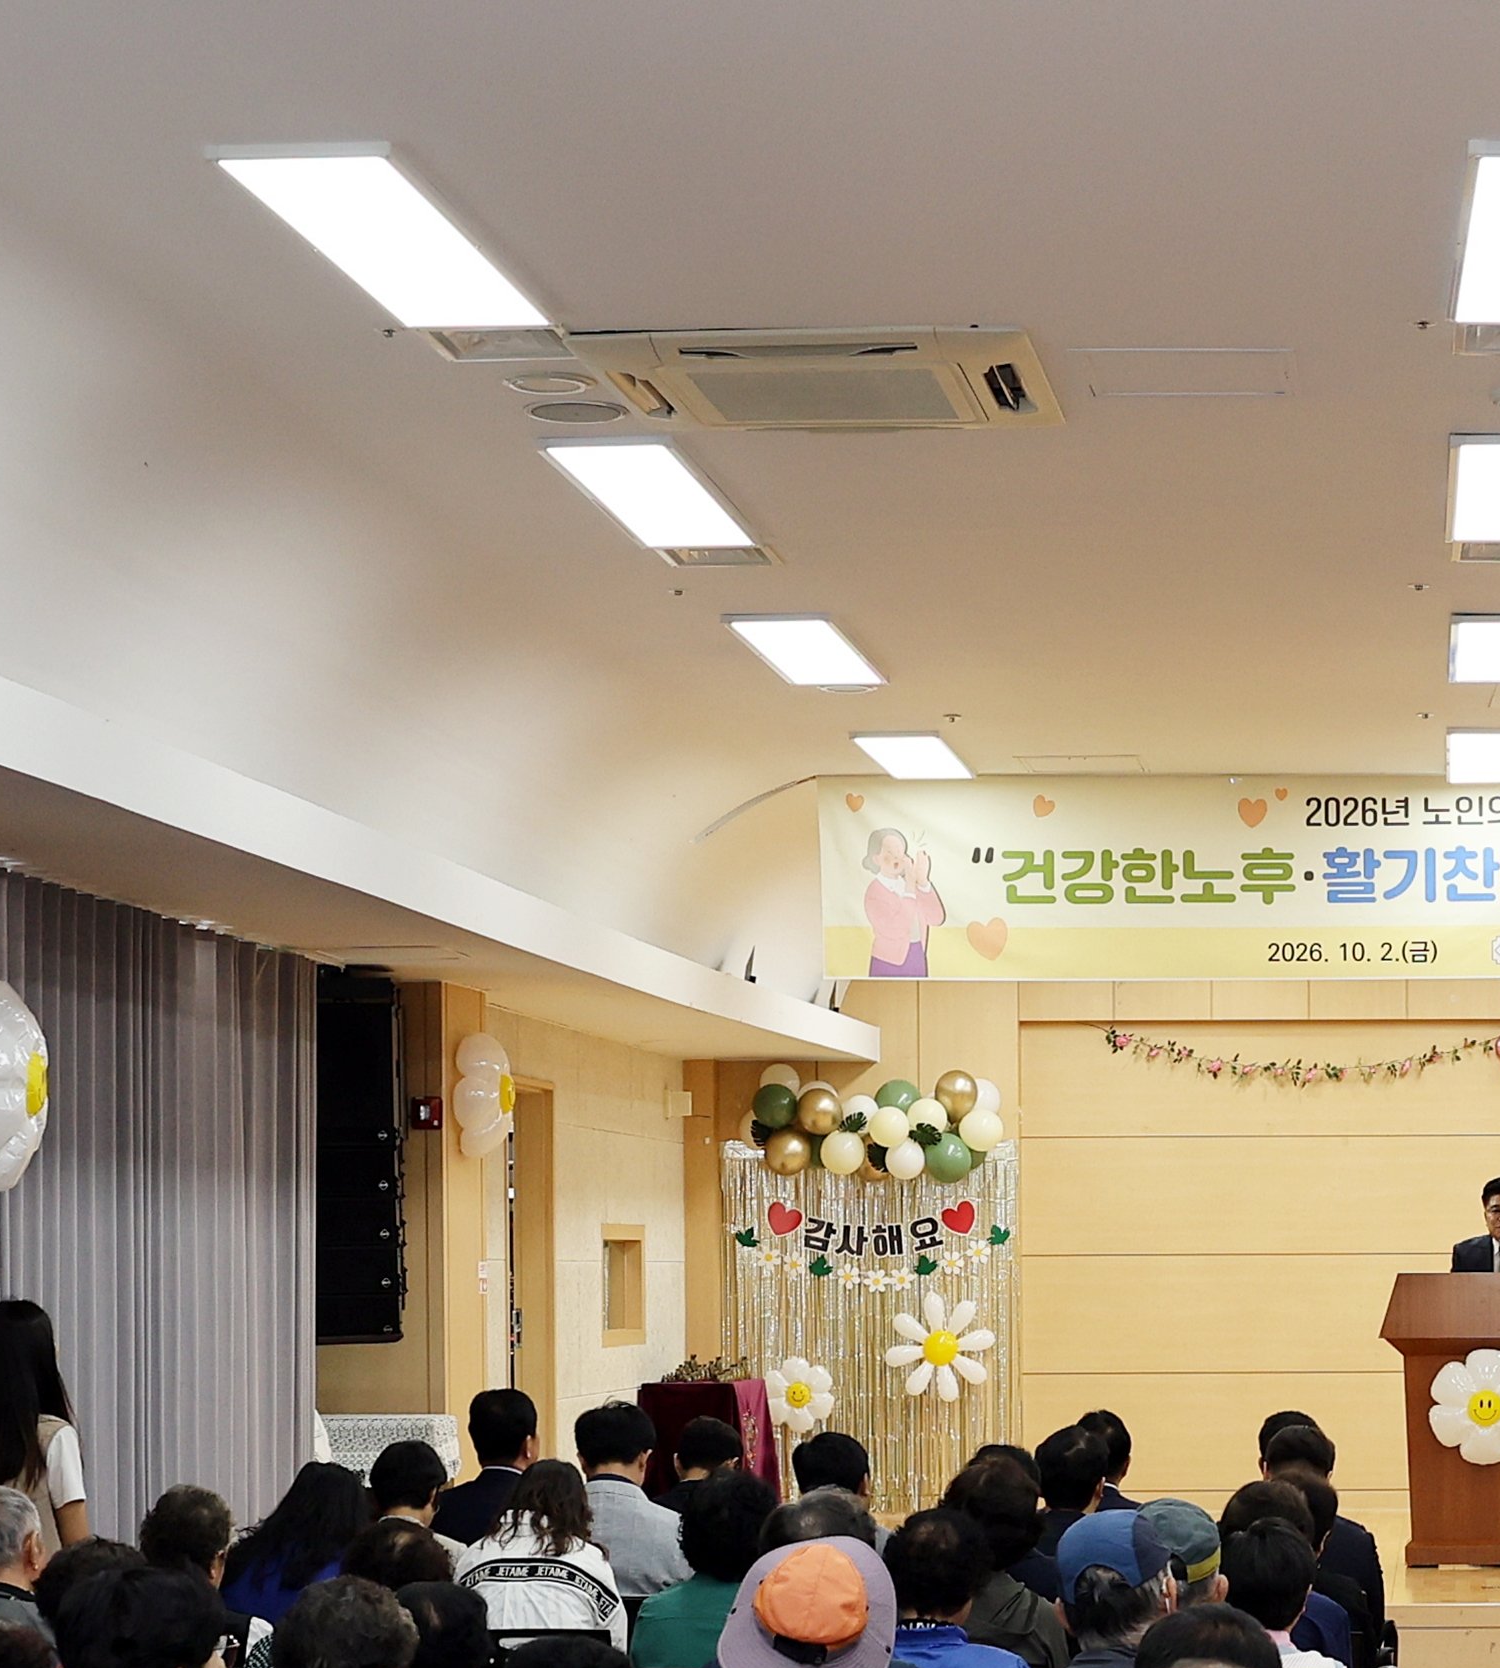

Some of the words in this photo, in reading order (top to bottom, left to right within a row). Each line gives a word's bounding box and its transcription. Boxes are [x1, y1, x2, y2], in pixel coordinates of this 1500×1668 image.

[1306, 797, 1409, 827] 2026년
[1268, 943, 1328, 962] 2026.
[1340, 942, 1371, 962] 10.
[1381, 941, 1437, 963] 2.(금)
[803, 1217, 944, 1256] 감사해요
[496, 1565, 530, 1577] JETAIME
[535, 1565, 569, 1580] JETAIME
